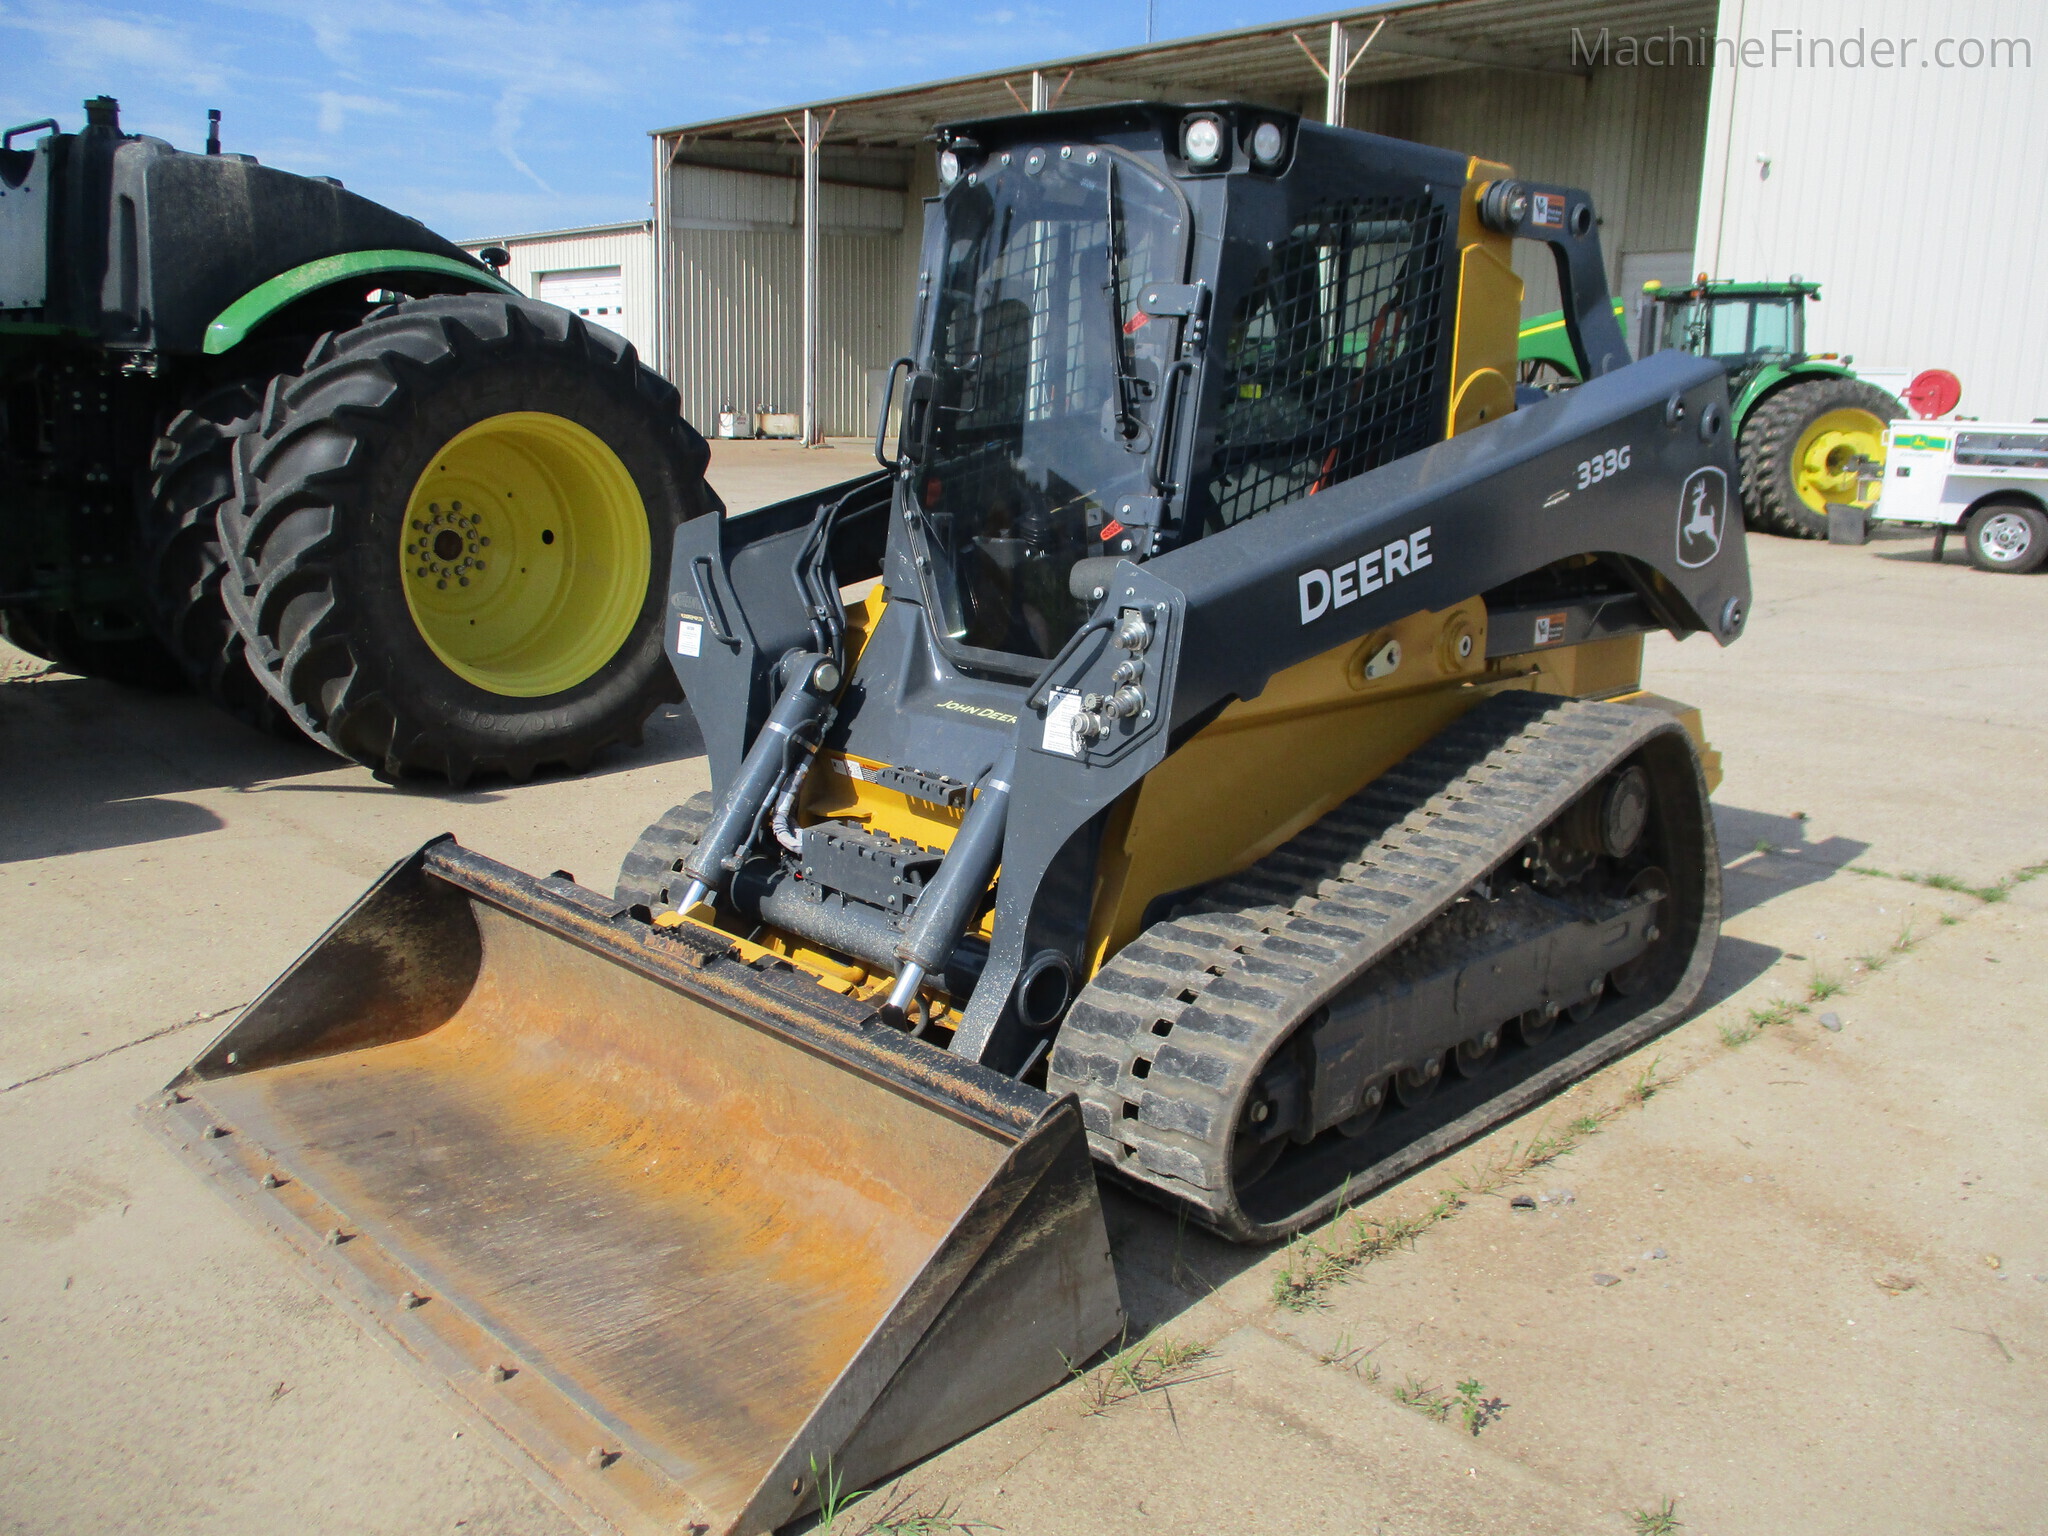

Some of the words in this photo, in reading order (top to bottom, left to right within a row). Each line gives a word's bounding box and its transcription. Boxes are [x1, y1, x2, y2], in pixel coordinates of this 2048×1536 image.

[1577, 444, 1631, 490] 333G
[1298, 525, 1433, 625] DEERE
[936, 700, 980, 714] JOHN
[977, 708, 1018, 724] DEER
